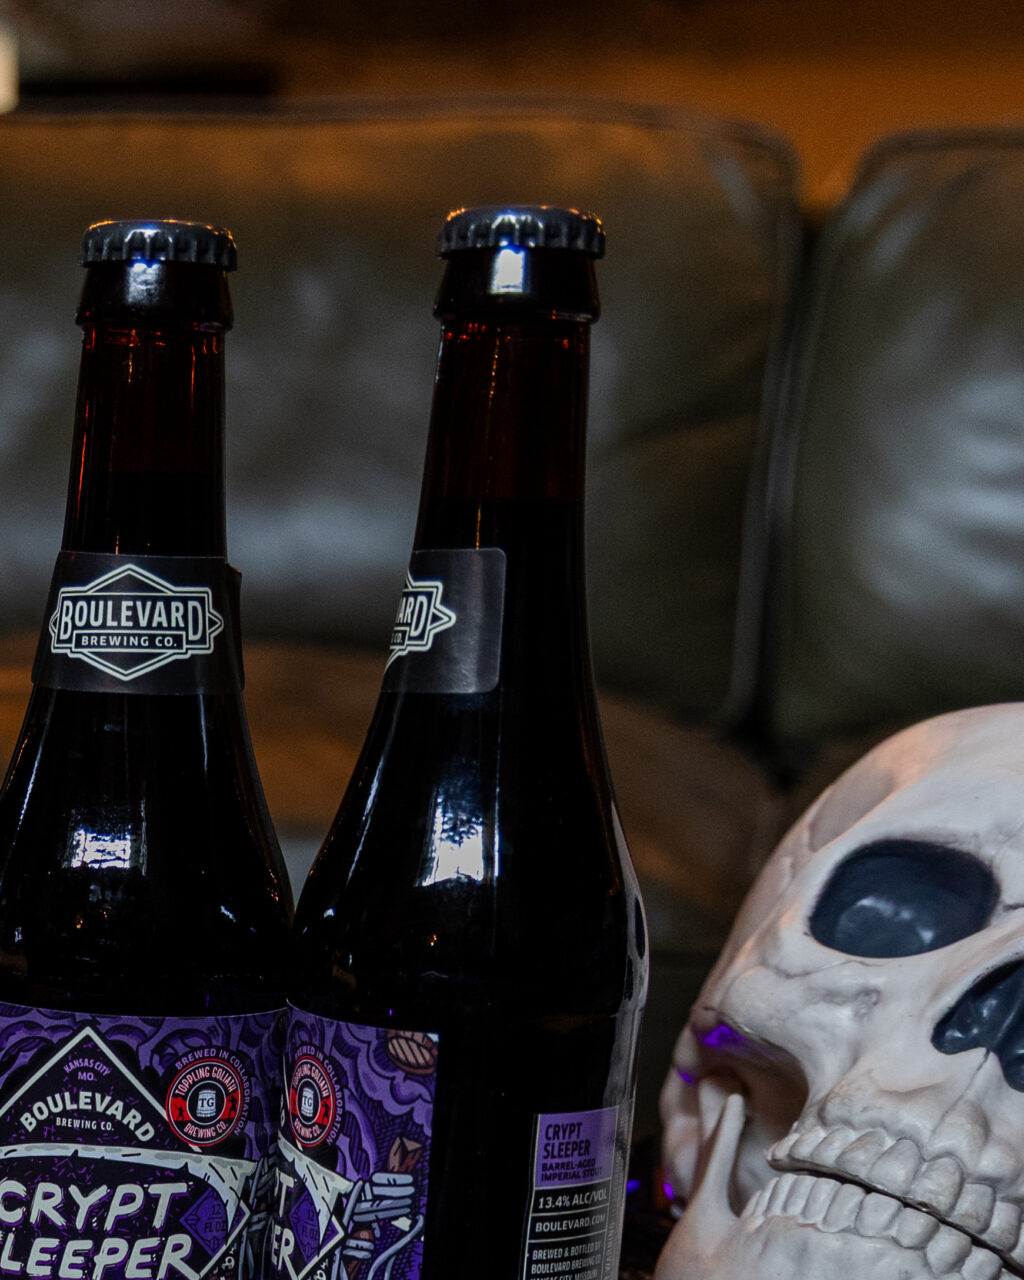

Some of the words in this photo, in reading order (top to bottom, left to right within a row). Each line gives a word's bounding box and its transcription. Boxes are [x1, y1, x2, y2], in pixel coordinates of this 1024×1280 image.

[59, 600, 203, 640] BOULEVARD
[81, 635, 149, 647] BREWING
[153, 636, 177, 647] CO.
[63, 1058, 95, 1074] KANSAS
[94, 1060, 113, 1076] CITY
[175, 1066, 210, 1096] TOPPLING
[211, 1066, 238, 1093] GOLIATH
[175, 1048, 216, 1070] BREWED
[218, 1049, 230, 1060] IN
[229, 1055, 251, 1136] COLLABORATION
[302, 1095, 313, 1107] TG
[198, 1098, 215, 1108] TG
[324, 1060, 344, 1145] COLLABORATION
[19, 1091, 155, 1142] BOULEVARD
[55, 1116, 97, 1130] BREWING
[100, 1121, 115, 1132] CO.
[183, 1122, 216, 1139] BREWING
[545, 1122, 583, 1141] CRYPT
[543, 1140, 590, 1159] SLEEPER
[541, 1158, 596, 1172] BARREL-AGED
[541, 1171, 580, 1182] IMPERIAL
[582, 1166, 603, 1179] STOUT
[538, 1195, 571, 1209] 13.4%
[571, 1188, 608, 1206] ALC/VOL
[212, 1203, 221, 1215] 12
[535, 1214, 606, 1233] BOULEVARD.COM
[532, 1248, 563, 1261] BREWED
[564, 1246, 570, 1257] &
[570, 1243, 594, 1256] BOTTLED
[531, 1260, 571, 1275] BOULEVARD
